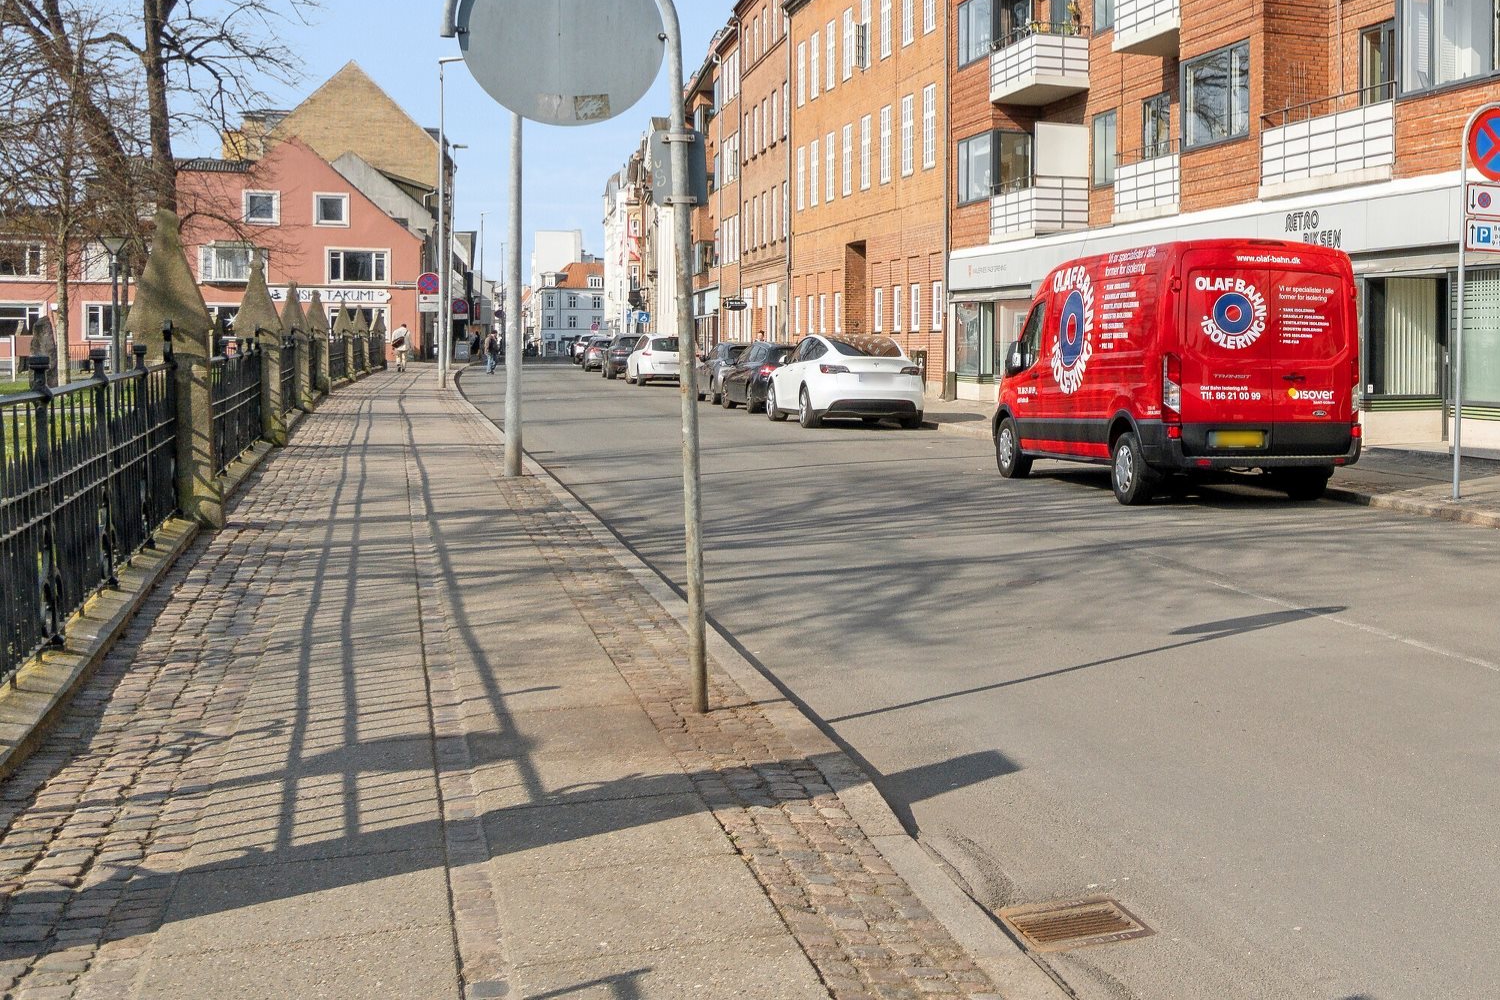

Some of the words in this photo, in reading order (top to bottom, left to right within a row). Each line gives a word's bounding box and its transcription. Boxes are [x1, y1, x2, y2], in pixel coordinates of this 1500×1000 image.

[1285, 210, 1319, 232] RETRO
[1236, 255, 1301, 264] www.olaf-bahn.dk
[1053, 266, 1077, 294] OLAF
[325, 290, 374, 301] TAKUMI
[1292, 286, 1322, 294] specialister
[1195, 276, 1234, 291] OLAF
[1235, 278, 1267, 318] BAHN
[1201, 318, 1266, 349] ISOLERING
[1200, 391, 1214, 400] Tlf.
[1216, 392, 1226, 400] 86
[1227, 392, 1237, 400] 21
[1239, 392, 1250, 400] 00
[1251, 392, 1261, 400] 99
[1299, 389, 1335, 400] isover
